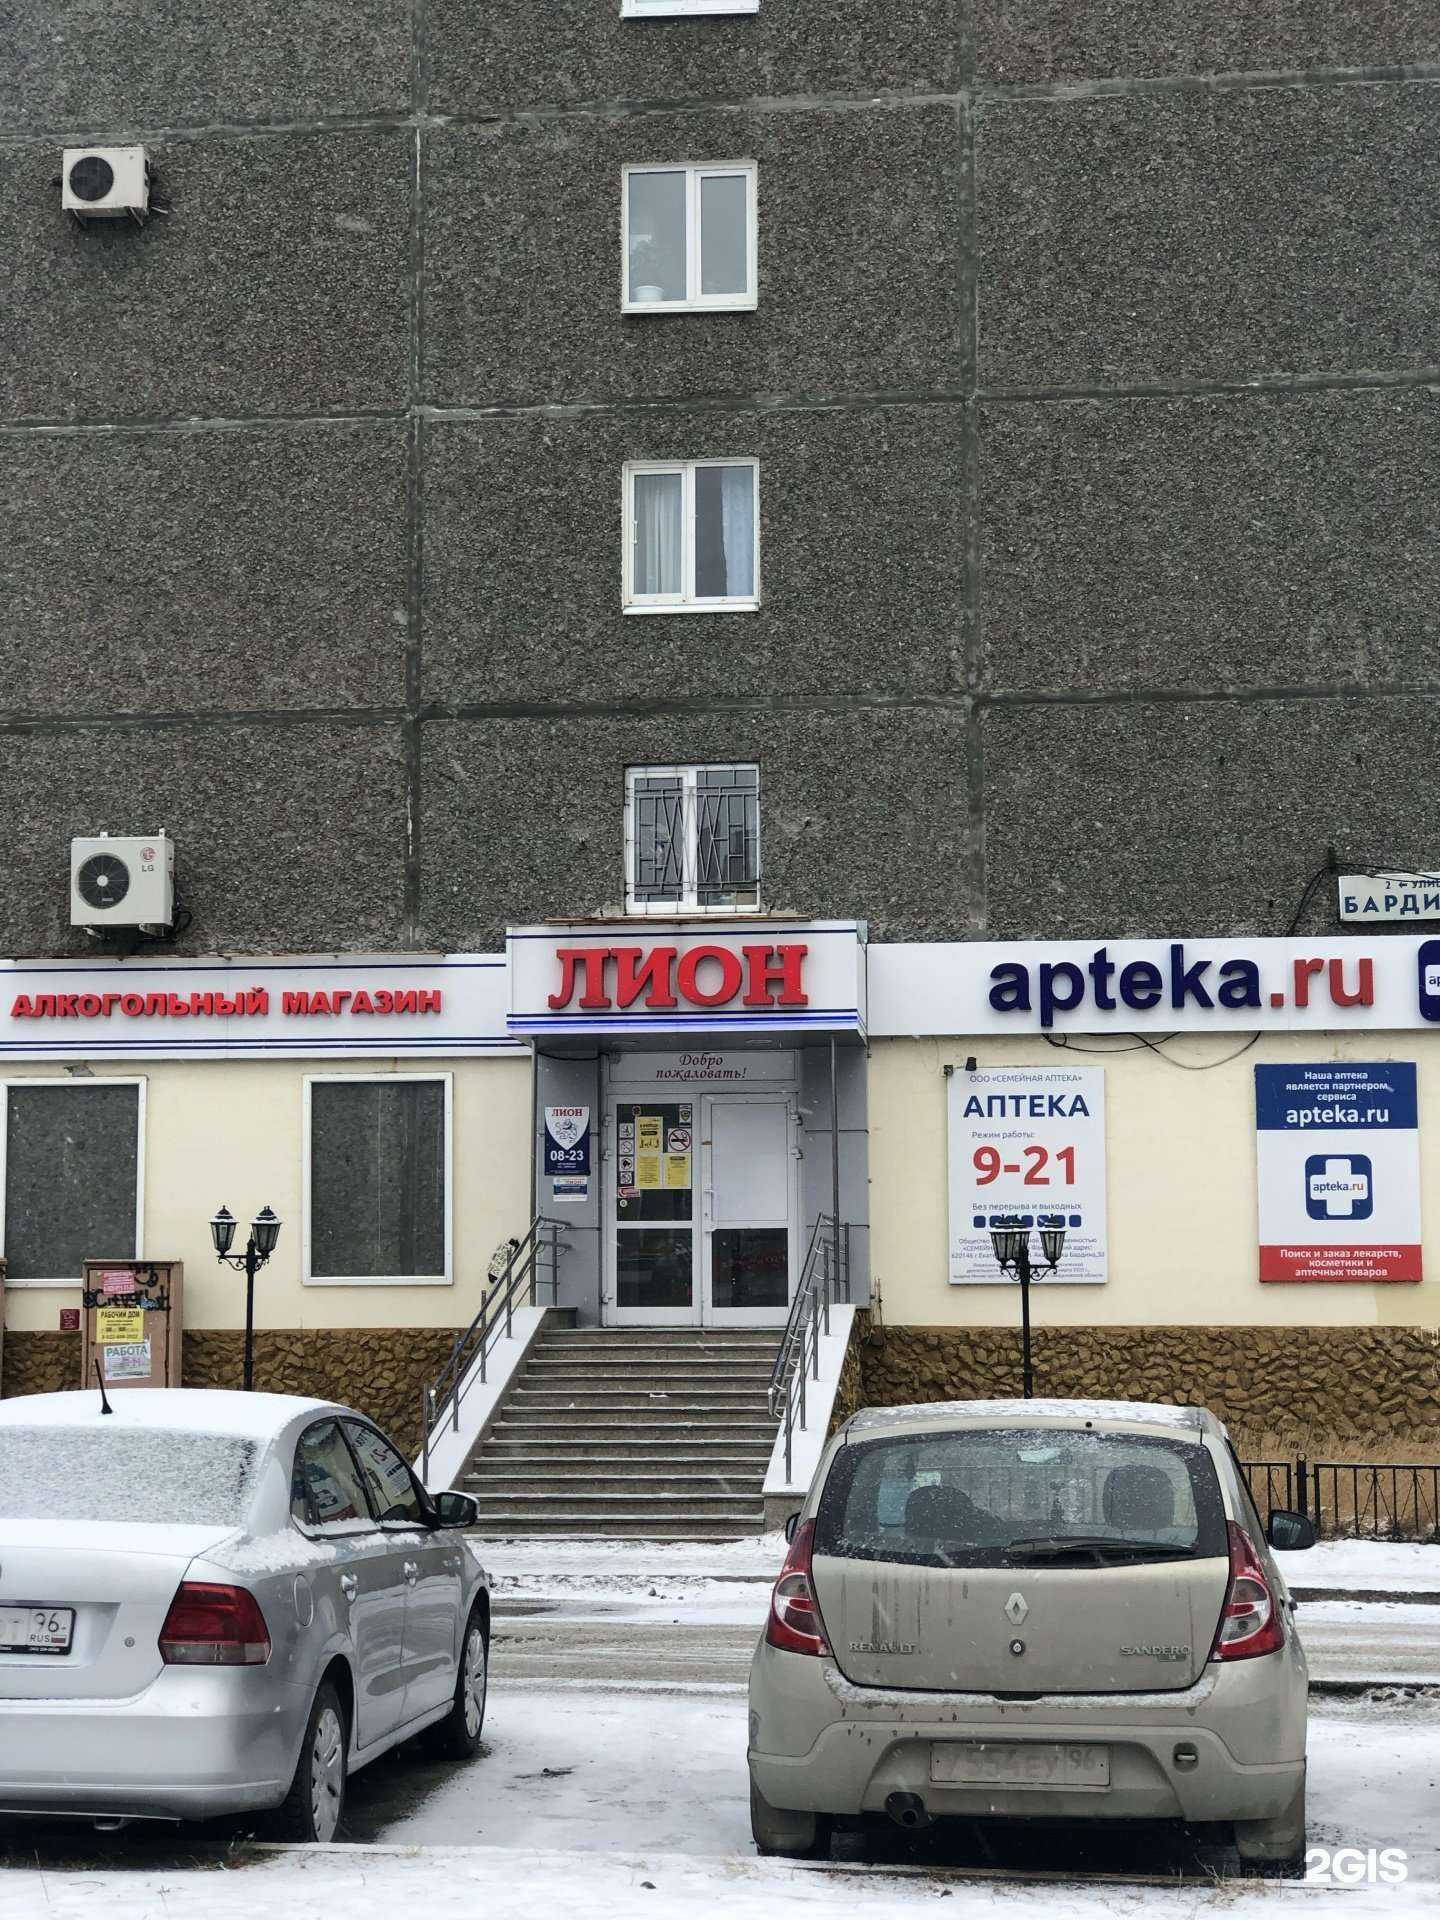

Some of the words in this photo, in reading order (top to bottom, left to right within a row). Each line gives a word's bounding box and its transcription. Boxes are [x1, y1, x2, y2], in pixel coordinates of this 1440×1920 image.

[141, 864, 155, 872] LG
[1385, 881, 1391, 889] 2
[548, 945, 809, 1009] ЛИОН
[989, 944, 1374, 1027] apteka.ru
[10, 986, 270, 1017] АЛКОГОЛЬНЫЙ
[282, 989, 442, 1015] МАГАЗИН
[679, 1054, 724, 1069] Добро
[656, 1067, 747, 1081] пожаловать!
[969, 1075, 990, 1083] ООО
[992, 1073, 1044, 1083] «СЕМЕЙНАЯ
[1045, 1073, 1083, 1082] АПТЕКА»
[1304, 1071, 1332, 1080] Наша
[1334, 1072, 1368, 1080] аптека
[1286, 1083, 1330, 1091] является
[1332, 1083, 1388, 1091] партнером
[1317, 1094, 1357, 1102] сервиса
[963, 1095, 1090, 1118] АПТЕКА
[1286, 1105, 1389, 1127] apteka.ru
[971, 1131, 1000, 1139] Режим
[550, 1150, 584, 1161] 08-23
[973, 1146, 1075, 1185] 9-21
[1313, 1181, 1364, 1193] apteka.ru
[972, 1203, 987, 1211] Без
[989, 1204, 1030, 1212] перерыва
[1039, 1203, 1082, 1211] выходных
[1280, 1249, 1311, 1258] Поиск
[1314, 1250, 1320, 1258] и
[1323, 1250, 1350, 1258] заказ
[1353, 1250, 1402, 1259] лекарств,
[1295, 1269, 1344, 1277] аптечных
[1347, 1269, 1388, 1277] товаров
[106, 1345, 148, 1357] РАБОТА
[34, 1612, 60, 1633] 96
[30, 1634, 51, 1643] RUS
[848, 1641, 916, 1654] RENAULT
[1120, 1644, 1192, 1656] SANDERO
